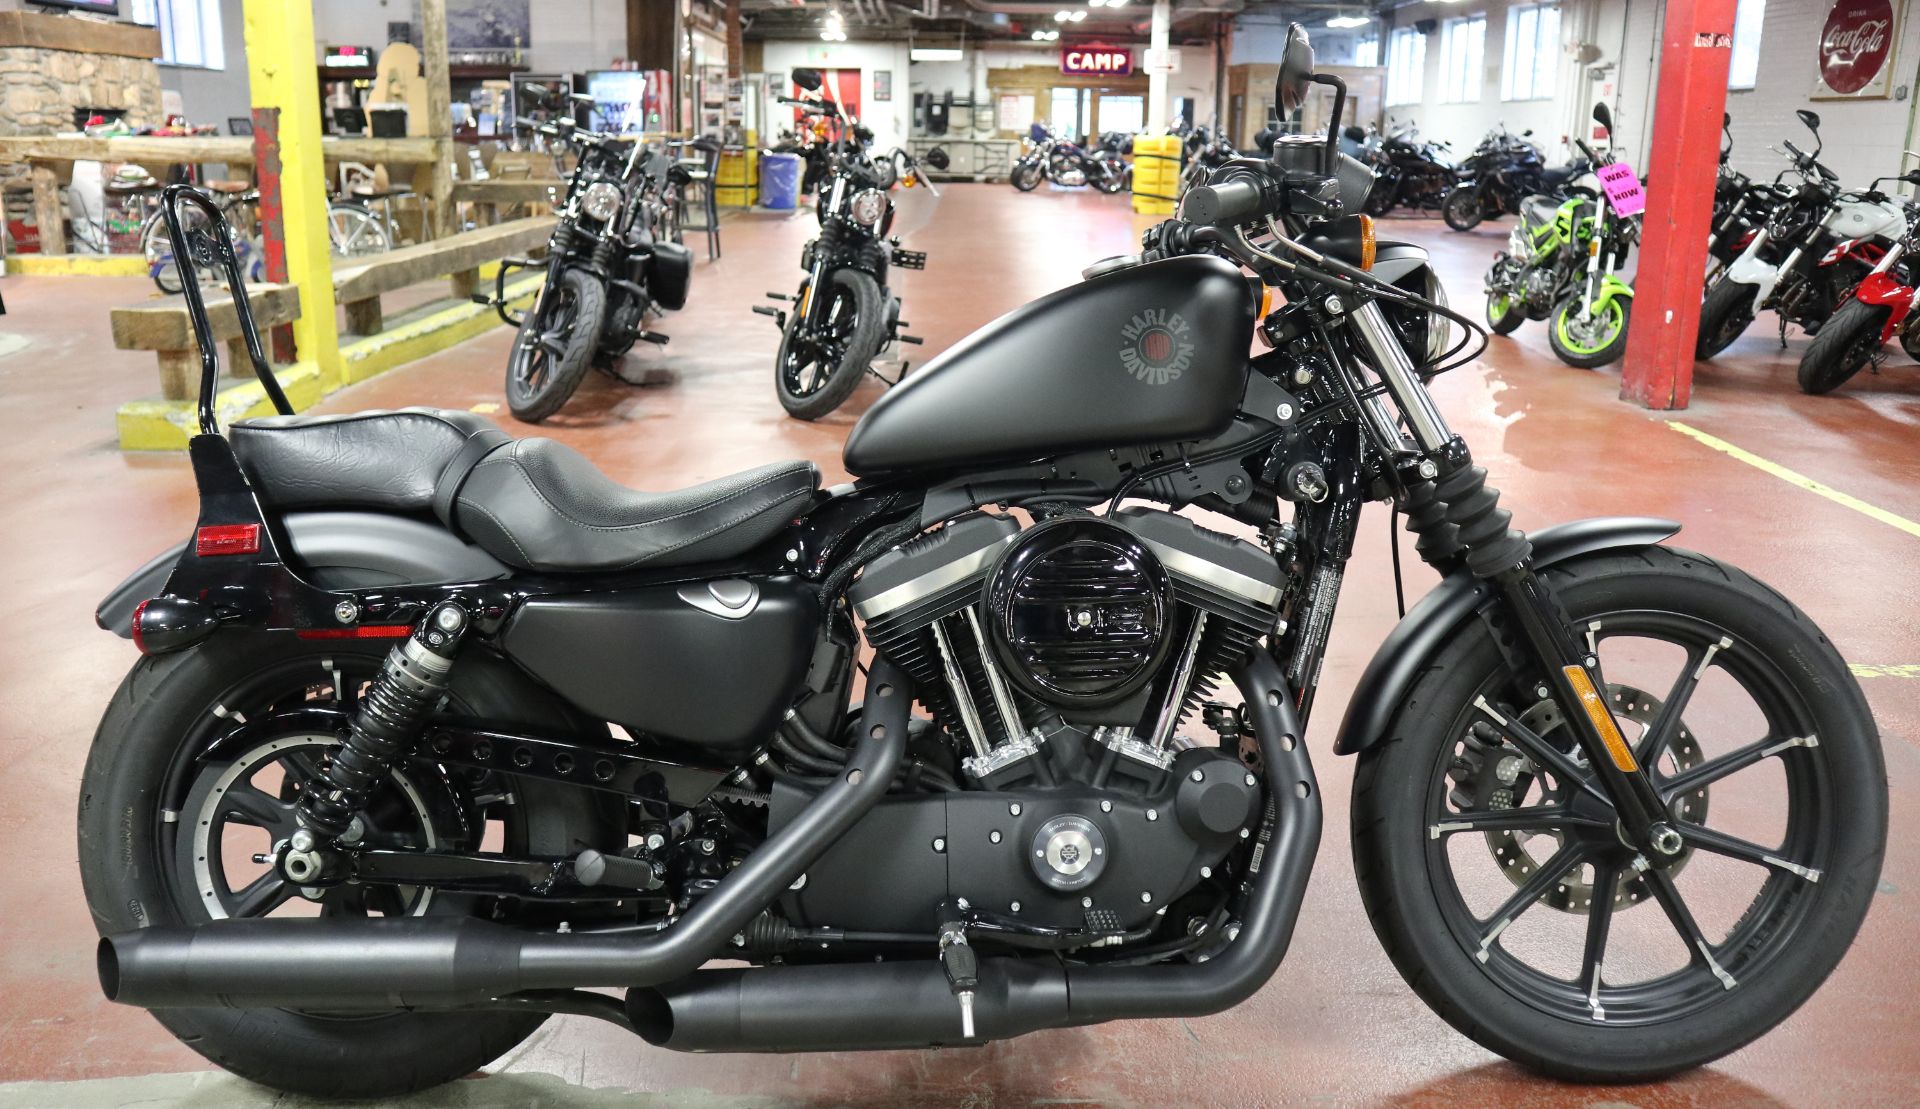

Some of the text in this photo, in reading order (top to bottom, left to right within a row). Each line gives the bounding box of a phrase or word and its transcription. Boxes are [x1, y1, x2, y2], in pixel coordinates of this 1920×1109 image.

[1066, 52, 1126, 71] CAMP
[1604, 170, 1630, 182] WAS
[1613, 188, 1639, 201] NOW
[1121, 308, 1191, 341] HARLEY
[1119, 343, 1195, 385] DAVIDSON
